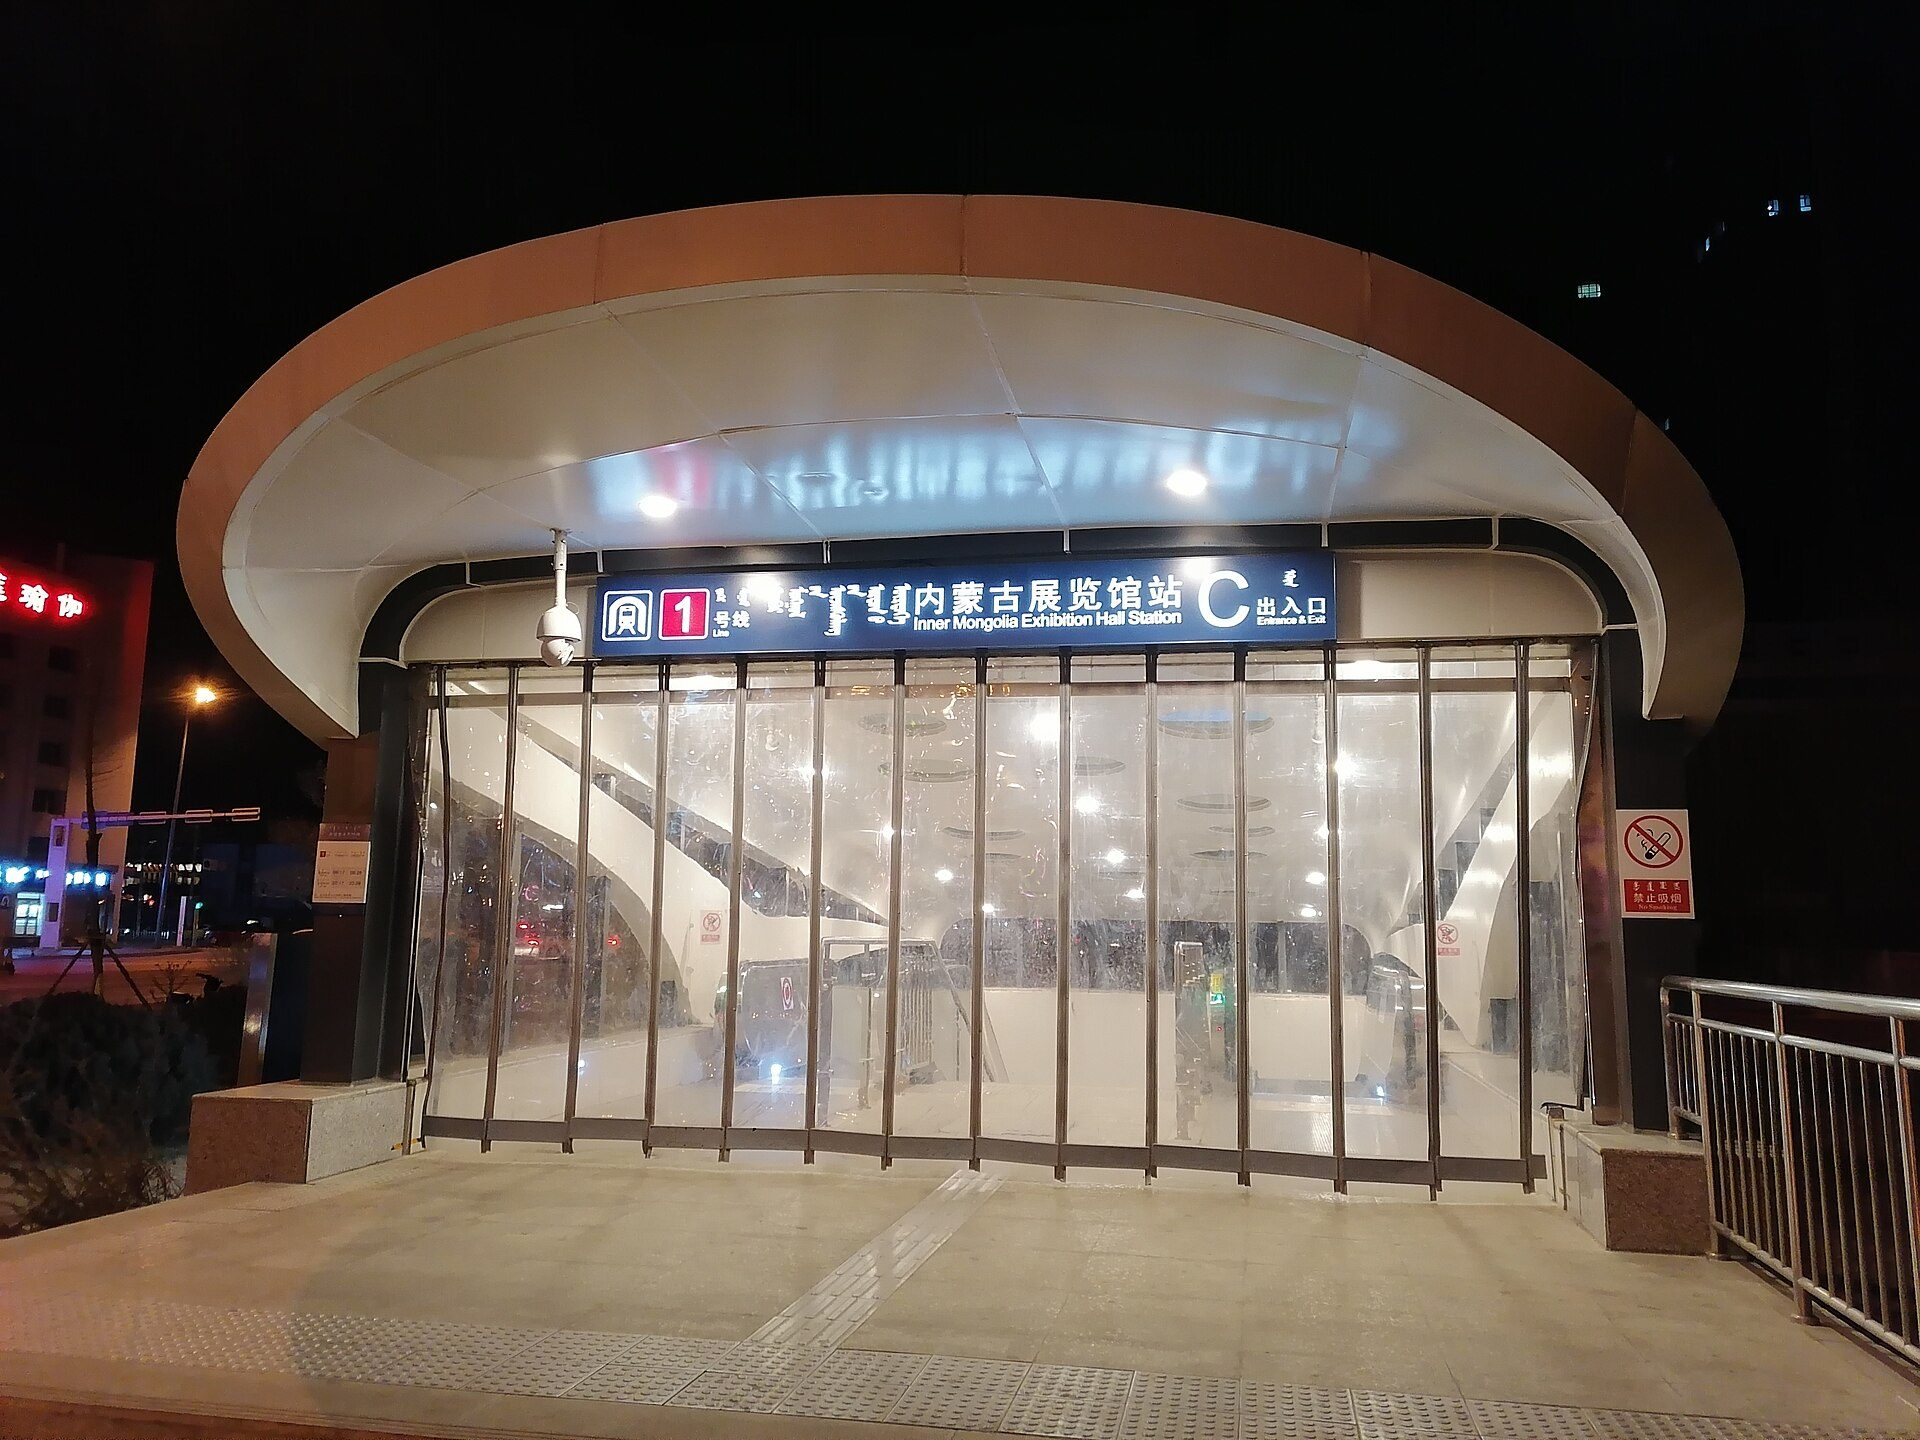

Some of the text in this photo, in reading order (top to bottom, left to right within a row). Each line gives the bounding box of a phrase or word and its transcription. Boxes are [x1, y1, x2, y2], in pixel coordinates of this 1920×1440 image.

[913, 574, 1183, 616] 内蒙古展览馆站
[1197, 569, 1250, 628] C
[675, 595, 692, 634] 1
[1256, 596, 1326, 617] 出入口
[713, 610, 751, 629] 号线
[913, 609, 1183, 632] Inner Mongolia Exhibition Hall Station
[1256, 614, 1327, 626] Entrance & Exit
[1633, 892, 1682, 904] 禁止吸烟
